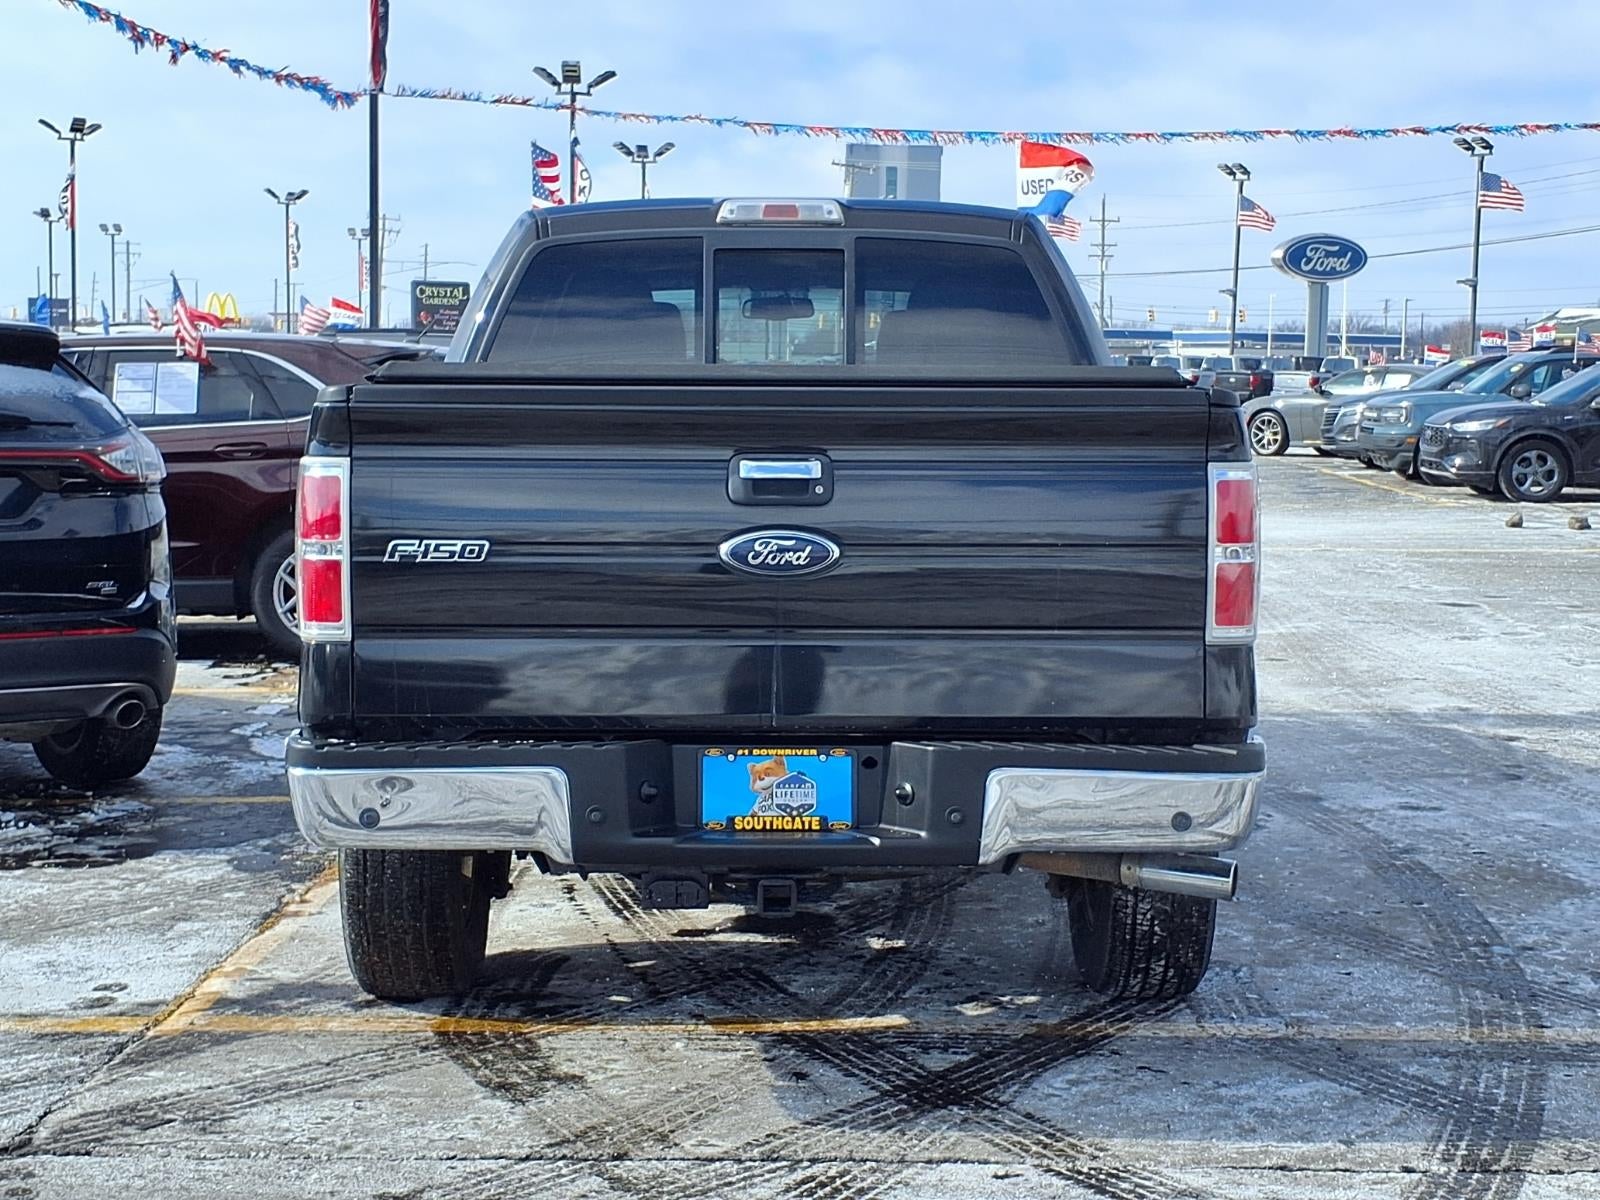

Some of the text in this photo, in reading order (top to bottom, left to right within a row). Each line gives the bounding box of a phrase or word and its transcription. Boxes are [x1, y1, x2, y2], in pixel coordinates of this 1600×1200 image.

[1301, 244, 1352, 272] Ford
[416, 285, 468, 300] CRYSTAL
[422, 297, 460, 306] GARDENS
[382, 539, 490, 563] F-150
[747, 538, 812, 565] Ford
[737, 748, 817, 756] #1 DOWNRIVER
[775, 790, 815, 799] LIFETIME
[734, 816, 820, 830] SOUTHGATE
